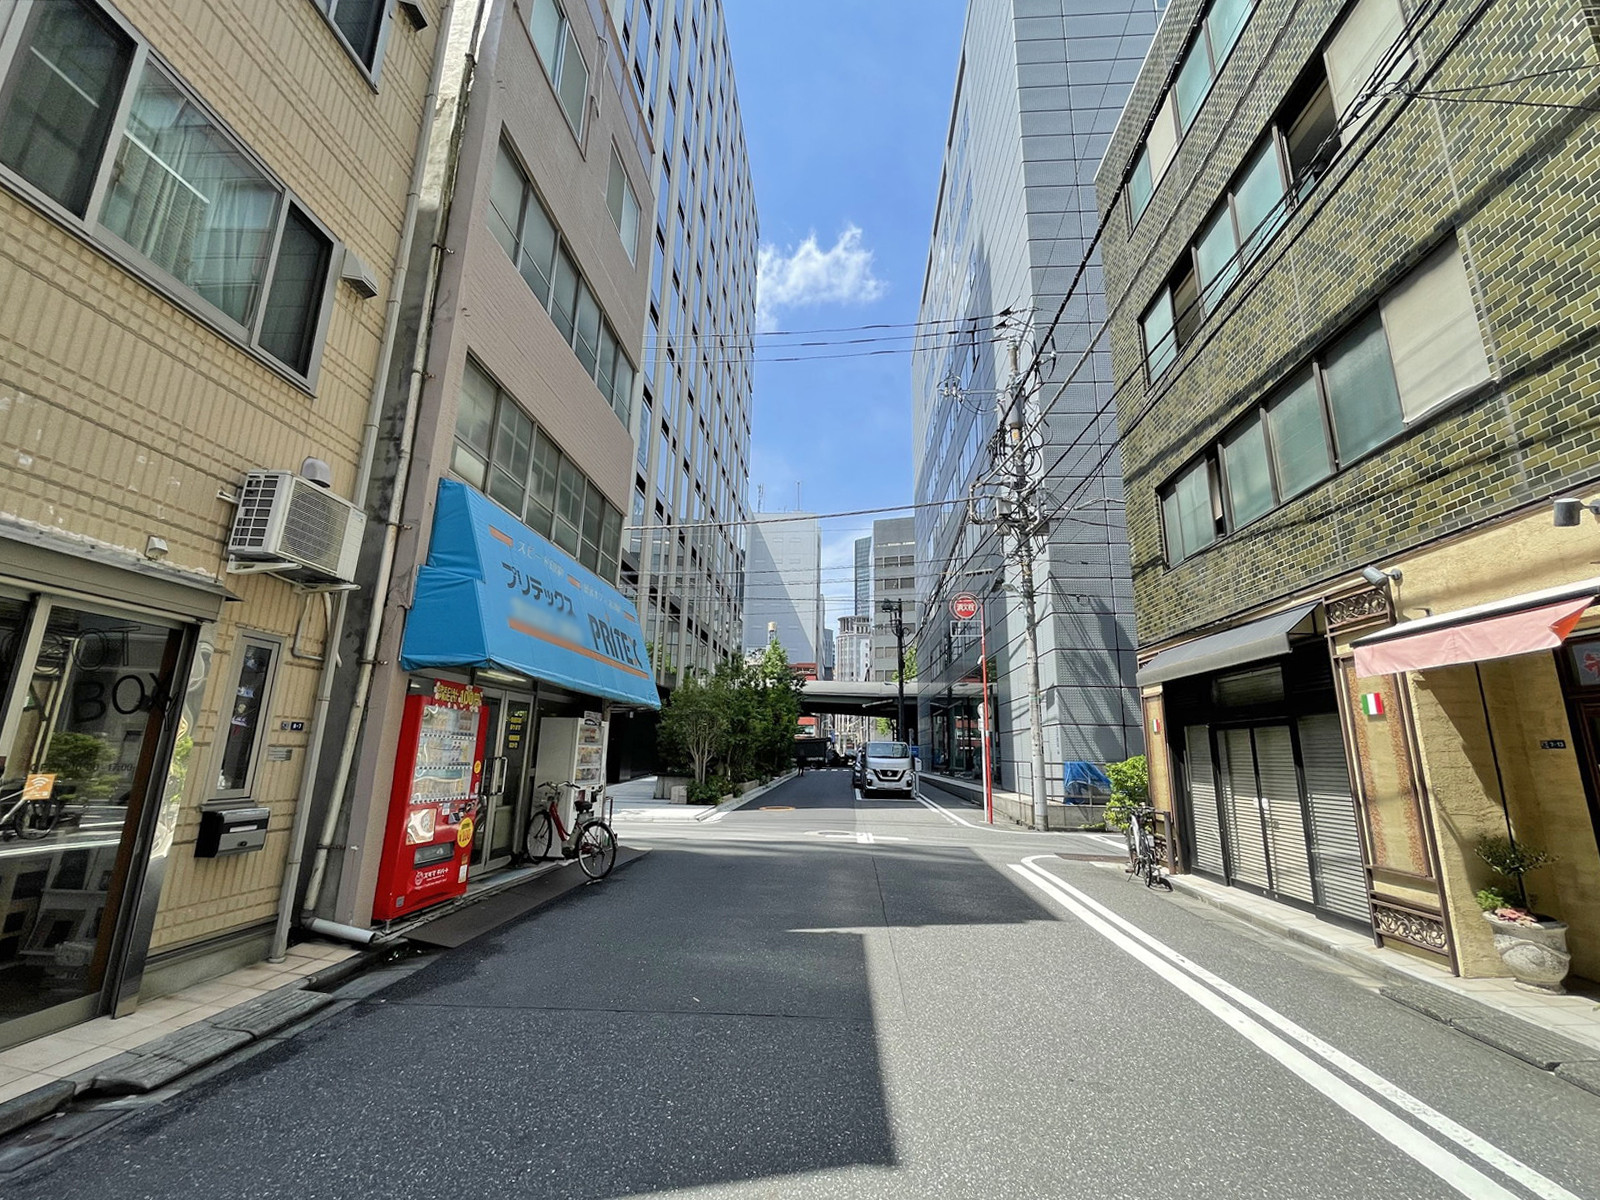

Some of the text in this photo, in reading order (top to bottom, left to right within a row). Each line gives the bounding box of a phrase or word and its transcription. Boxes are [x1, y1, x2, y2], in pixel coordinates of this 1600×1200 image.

[502, 562, 576, 617] プリテックス
